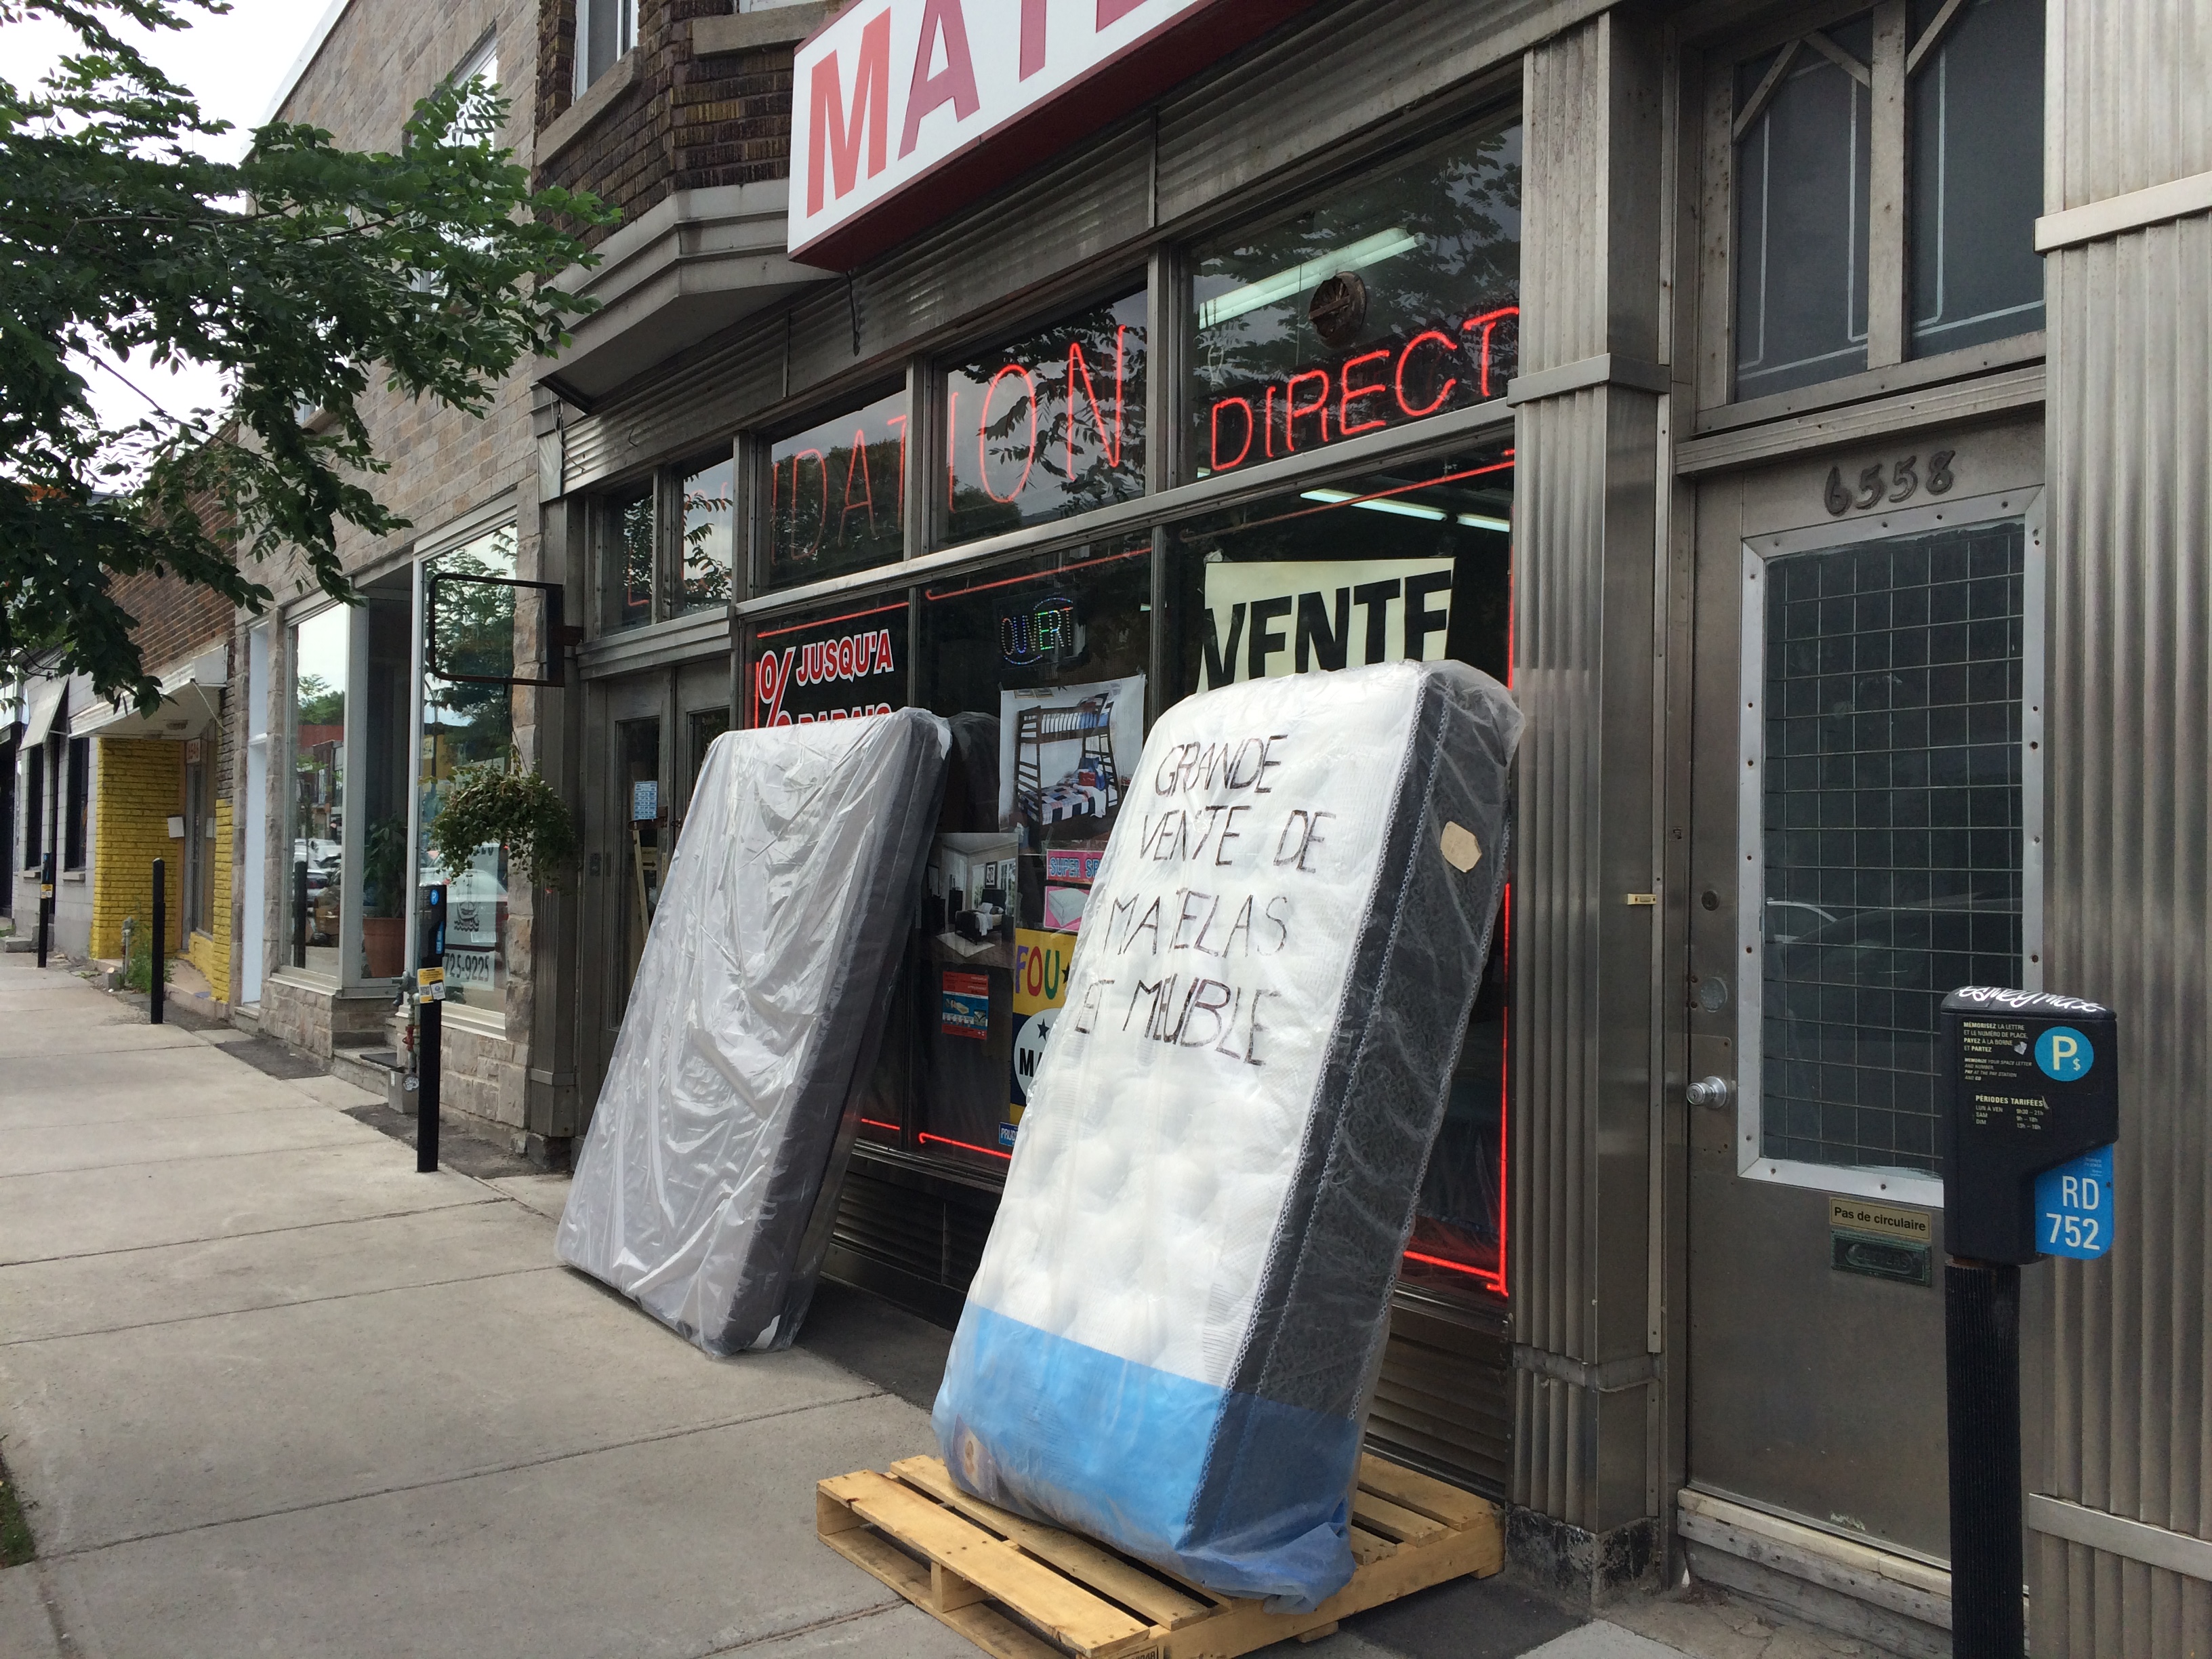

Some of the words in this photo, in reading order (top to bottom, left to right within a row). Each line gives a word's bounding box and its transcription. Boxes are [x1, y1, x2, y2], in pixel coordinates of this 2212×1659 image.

[806, 0, 1147, 218] MA
[1212, 306, 1519, 470] DIRECT
[1824, 450, 1956, 516] 6558
[796, 629, 893, 687] JUSQU'A
[1001, 607, 1073, 655] OUVERT
[1204, 570, 1452, 693] VENTE
[1155, 735, 1288, 797] GRANDE
[1140, 805, 1252, 866] VENTE
[1273, 810, 1336, 873] DE
[1050, 857, 1080, 878] SUPER
[1086, 859, 1102, 878] SP
[1015, 945, 1060, 1000] FOU
[1075, 979, 1115, 1034] ET
[1122, 973, 1282, 1066] MEUBLE
[1975, 1094, 2009, 1104] PÉRIODES
[2011, 1098, 2043, 1107] TARIFÉES
[1001, 1128, 1018, 1141] PRUD
[1834, 1206, 1854, 1219] Pas
[1857, 1210, 1871, 1222] de
[1874, 1214, 1926, 1231] circulaire
[2062, 1175, 2100, 1210] RD
[2046, 1212, 2100, 1250] 752
